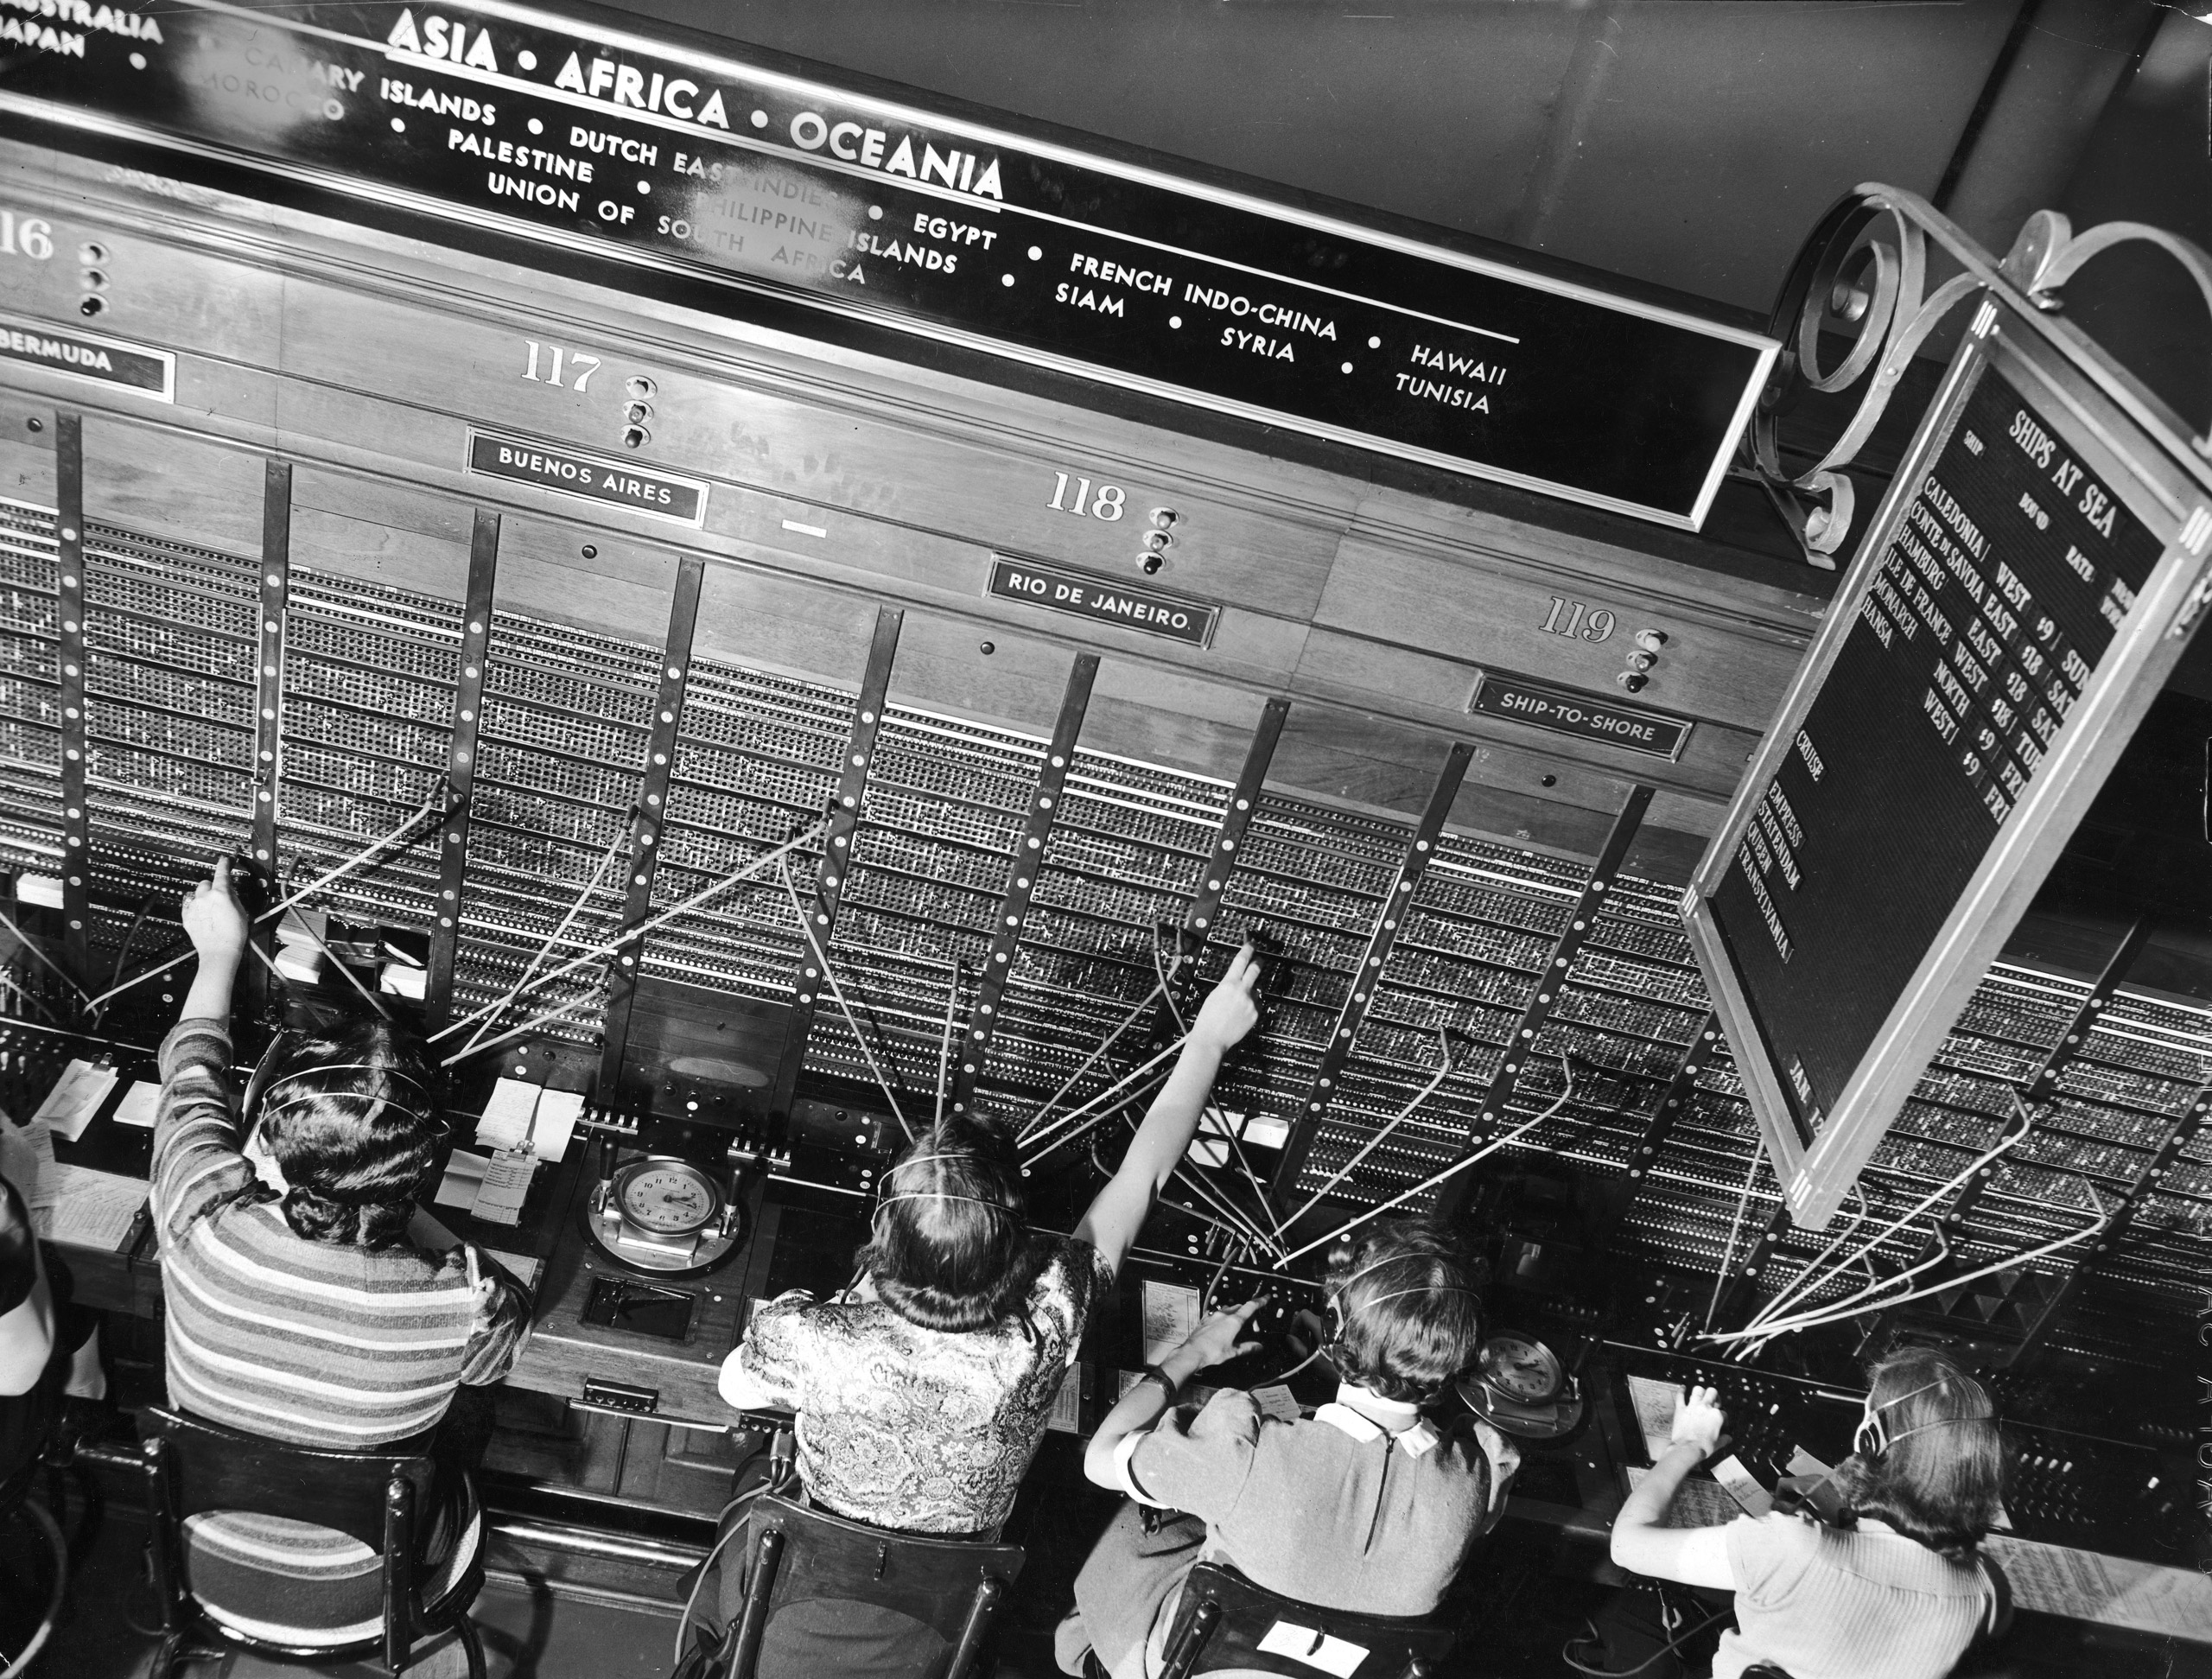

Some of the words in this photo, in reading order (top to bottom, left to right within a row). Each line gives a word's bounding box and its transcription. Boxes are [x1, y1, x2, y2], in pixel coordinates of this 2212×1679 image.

[387, 8, 499, 73] ASIA
[554, 50, 731, 130] AFRICA
[790, 111, 1004, 200] OCEANIA
[245, 47, 366, 92] CAARY
[380, 78, 496, 127] ISLANDS
[569, 126, 658, 167] DUTCH
[912, 213, 998, 250] EGYPT
[1070, 253, 1173, 296] FRENCH
[1184, 283, 1337, 341] INDO-CHINA
[1410, 344, 1507, 386] HAWAII
[488, 172, 580, 213] UNION
[597, 200, 636, 225] OF
[658, 215, 745, 253] SOUTH
[448, 129, 594, 184] PALESTINE
[696, 191, 833, 243] PHILIPPINE
[847, 229, 958, 275] ISLANDS
[1055, 283, 1125, 318] SIAM
[1220, 327, 1295, 363] SYRIA
[1395, 373, 1490, 415] TUNISIA
[520, 340, 601, 393] 117
[499, 448, 593, 484] BUENOS
[602, 473, 671, 505] AIRES
[1046, 471, 1127, 522] 118
[2009, 410, 2056, 469] SHIPS
[2050, 458, 2084, 496] AT
[2078, 483, 2117, 538] SEA
[1898, 524, 1947, 590] HAMBURG
[1967, 617, 2002, 666] EAST
[1910, 499, 1944, 548] CONTE
[1939, 537, 1950, 556] DI
[1947, 547, 1985, 604] SAVOIA
[1982, 592, 2018, 640] EAST
[1923, 475, 1985, 560] CALEDONIA
[1996, 561, 2031, 612] WEST
[1007, 572, 1047, 595] RIO
[1054, 583, 1084, 604] DE
[1090, 594, 1189, 629] JANEIRO
[1538, 595, 1617, 644] 119
[1884, 546, 1904, 578] ILE
[1899, 568, 1916, 596] DE
[1912, 586, 1954, 646] FRANCE
[1954, 639, 1989, 693] WEST
[1500, 692, 1656, 741] SHIP-TO-SHORE
[1861, 595, 1894, 650] HANSA
[1923, 687, 1955, 740] WEST
[1983, 783, 2011, 825] FRI
[1872, 571, 1920, 641] MONARCH
[1933, 658, 1971, 718] NORTH
[1999, 760, 2027, 801] FRI
[1796, 728, 1824, 781] CRUISE
[1747, 820, 1773, 874] QUEEN
[1758, 799, 1801, 891] STATENDAM
[1768, 779, 1803, 848] EMPRESS
[1738, 840, 1789, 959] TRANSYLVANIA
